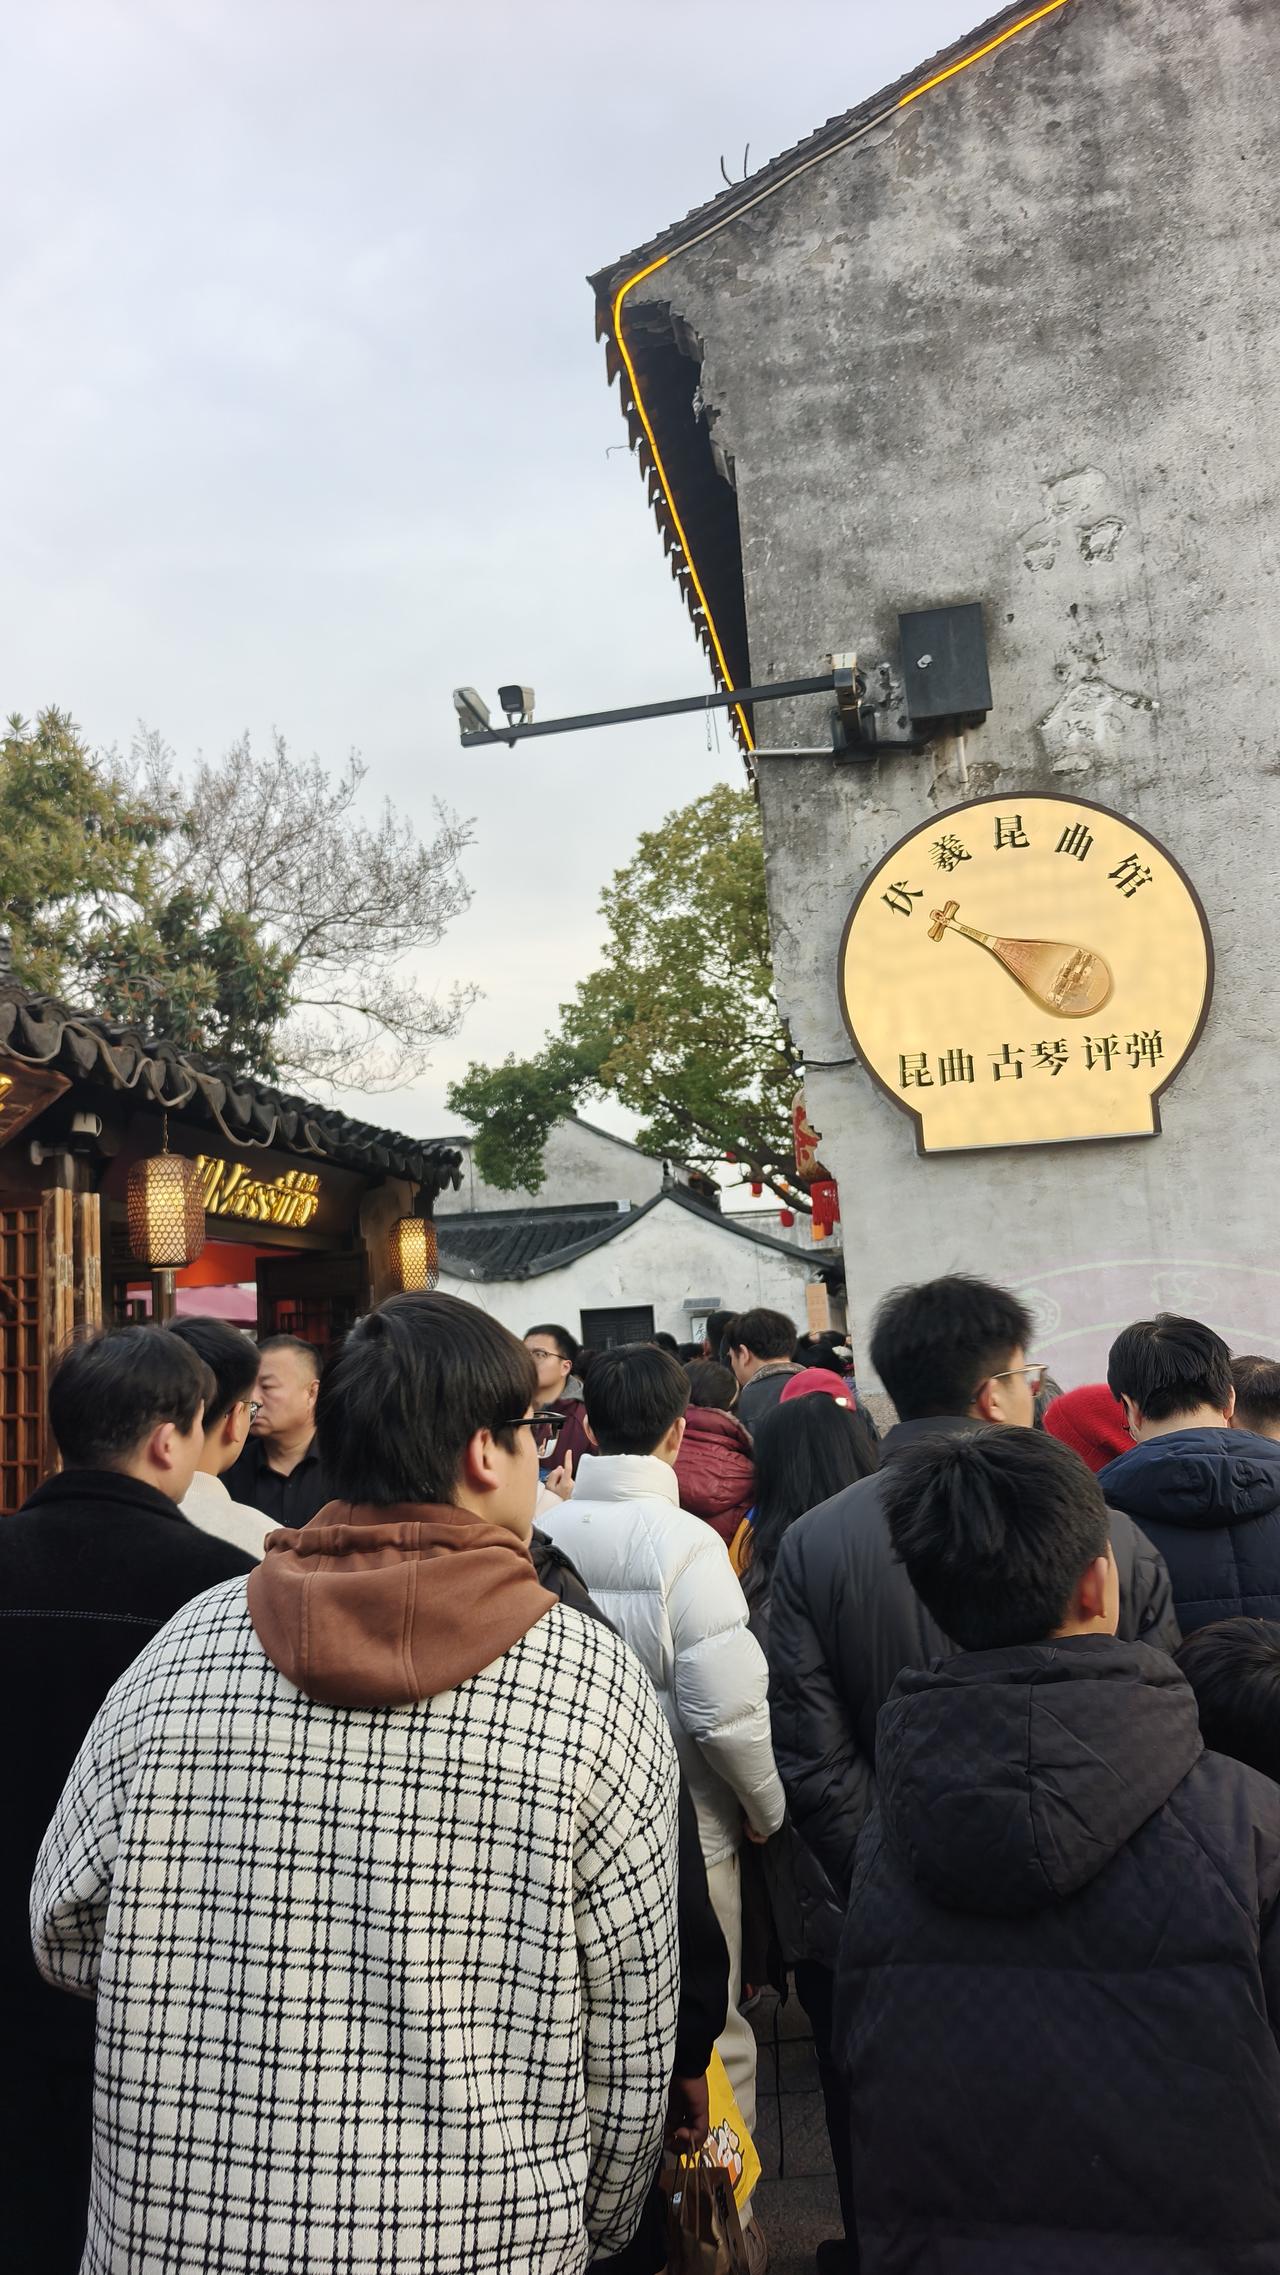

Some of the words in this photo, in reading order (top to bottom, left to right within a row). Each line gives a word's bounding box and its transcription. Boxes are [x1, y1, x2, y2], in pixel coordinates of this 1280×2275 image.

[880, 814, 1153, 917] 伏羲昆曲馆
[898, 1048, 975, 1089] 昆曲
[987, 1038, 1070, 1082] 古琴
[1081, 1029, 1165, 1072] 评弹
